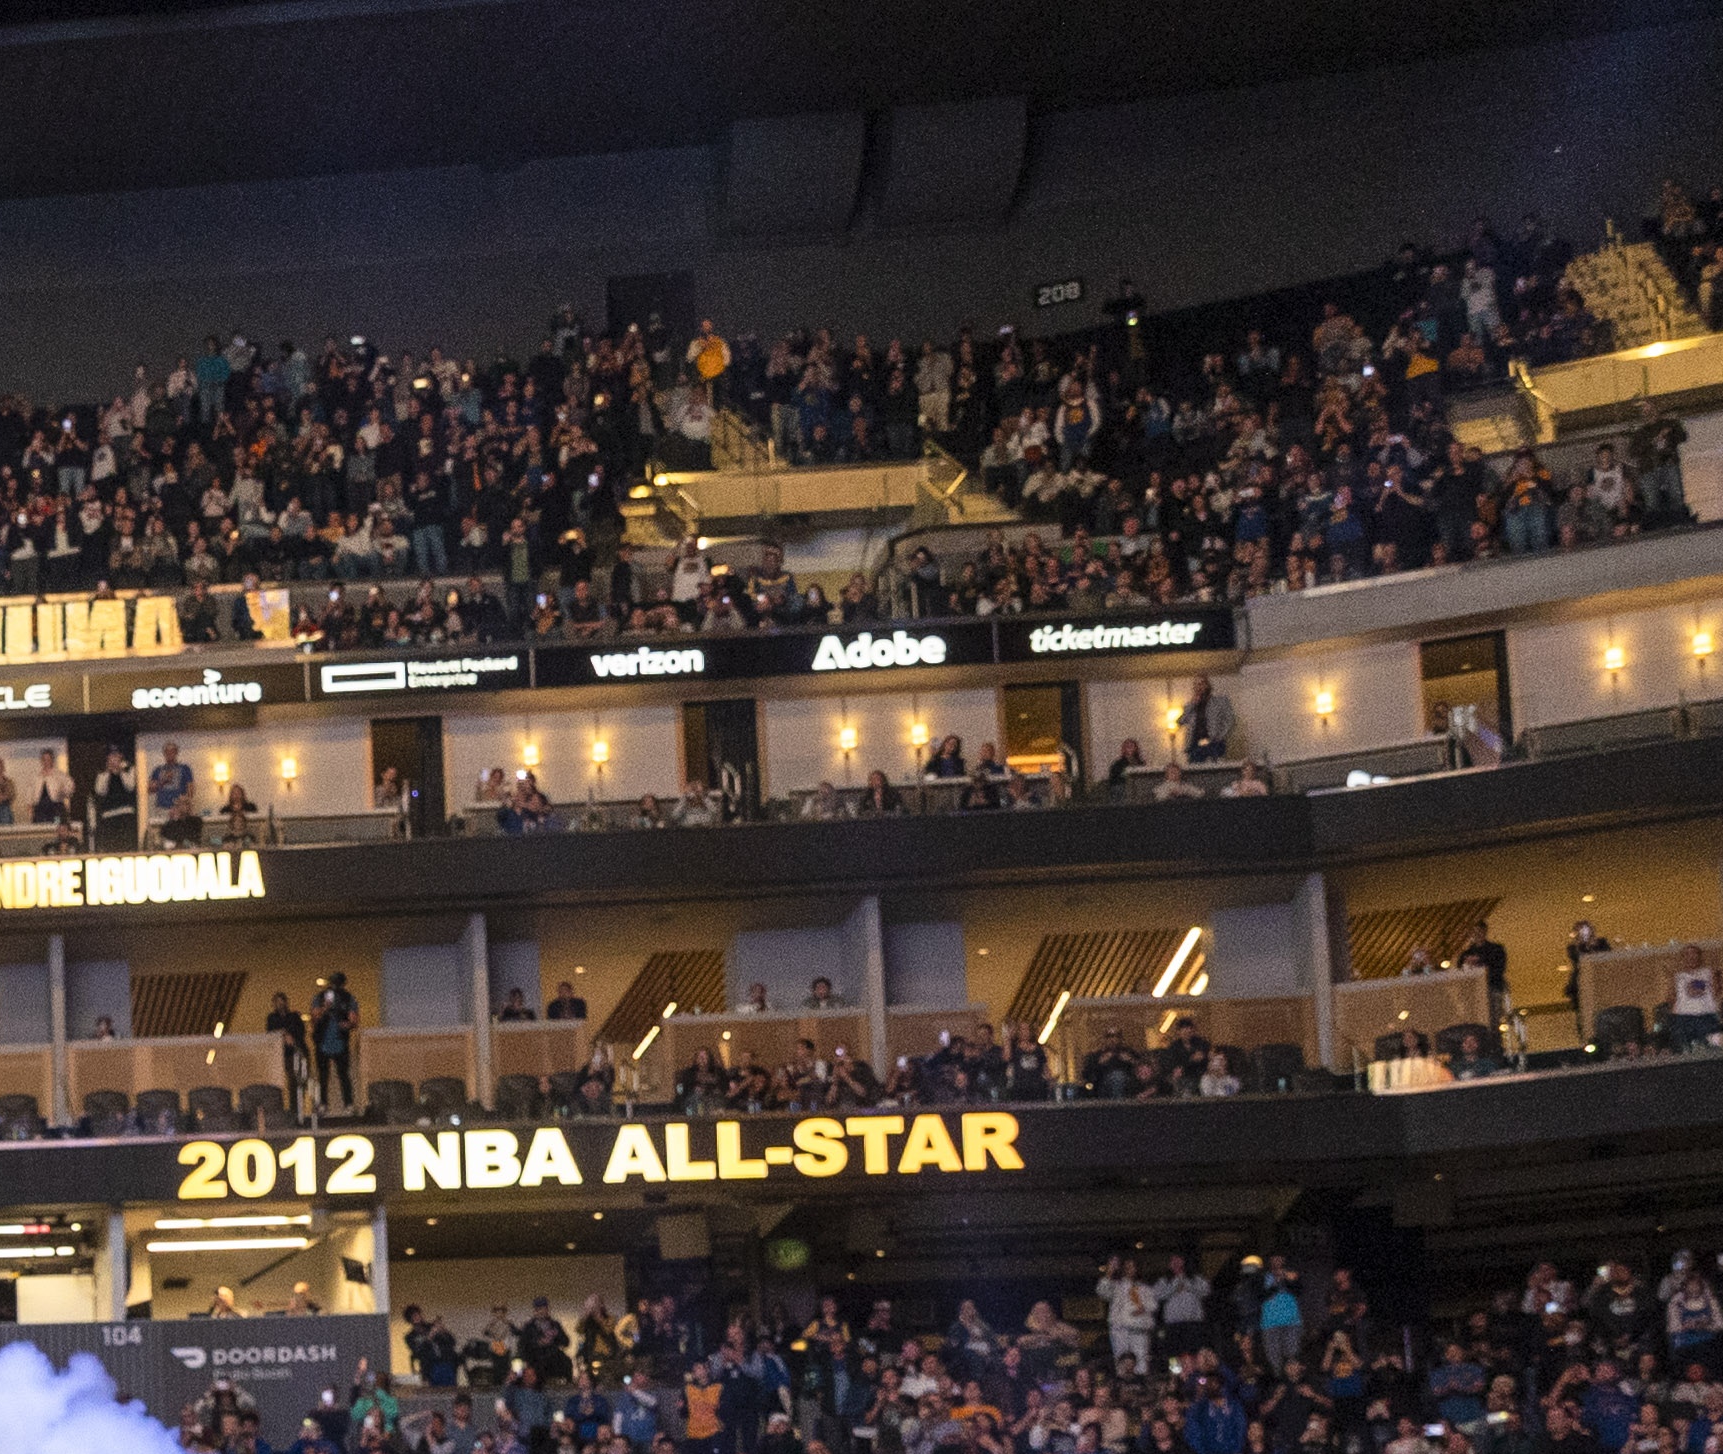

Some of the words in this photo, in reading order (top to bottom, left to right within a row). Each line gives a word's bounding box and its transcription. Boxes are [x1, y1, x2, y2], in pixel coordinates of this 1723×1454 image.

[1038, 281, 1081, 306] 208
[811, 630, 947, 670] Adobe
[1029, 620, 1202, 653] ticketmaster
[590, 646, 705, 677] verizon
[131, 680, 262, 709] accenture
[85, 850, 267, 906] IGUODALA
[176, 1135, 377, 1200] 2012
[401, 1127, 584, 1192] NBA
[601, 1111, 1027, 1185] ALL-STAR
[102, 1325, 143, 1347] 104
[212, 1345, 337, 1366] DOORDASH
